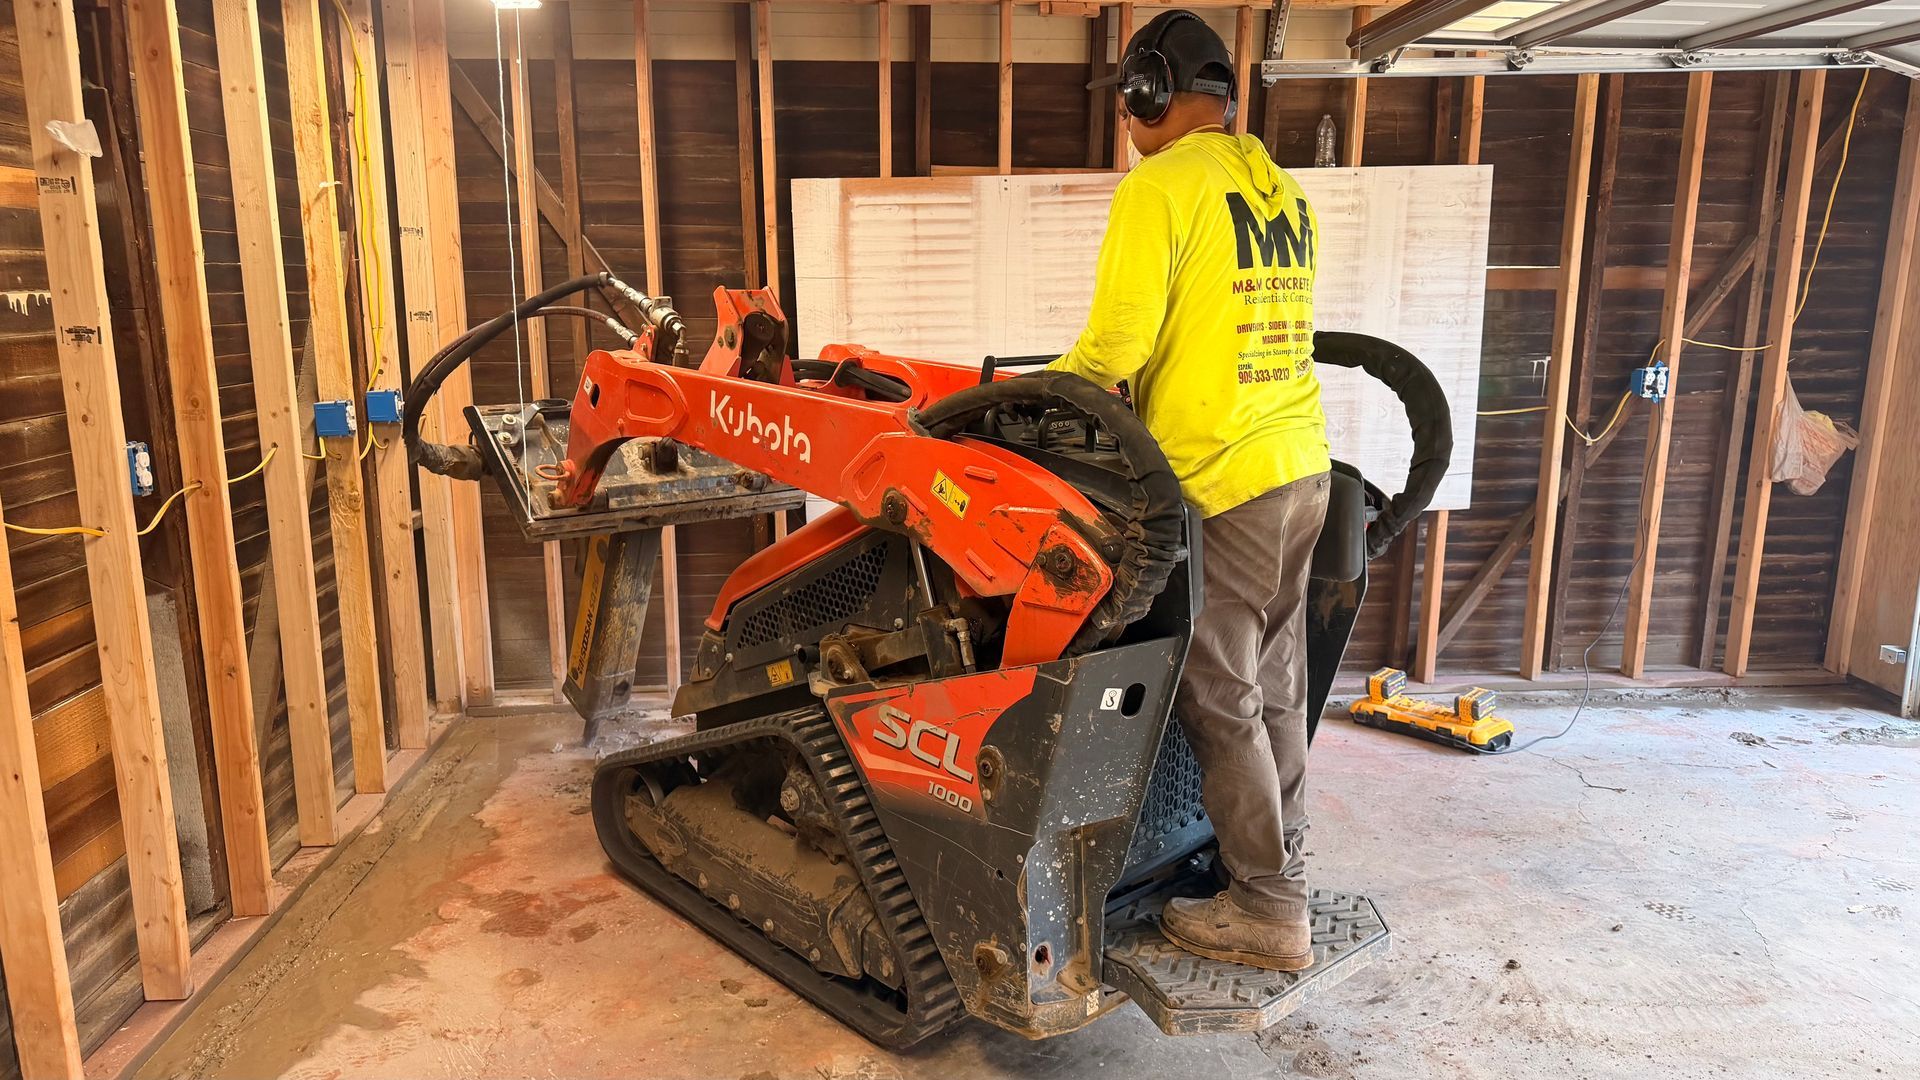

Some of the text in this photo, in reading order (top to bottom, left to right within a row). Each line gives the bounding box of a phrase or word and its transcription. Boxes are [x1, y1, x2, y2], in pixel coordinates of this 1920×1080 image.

[710, 389, 811, 464] Kubota
[873, 704, 974, 783] SCL
[928, 780, 973, 814] 1000
